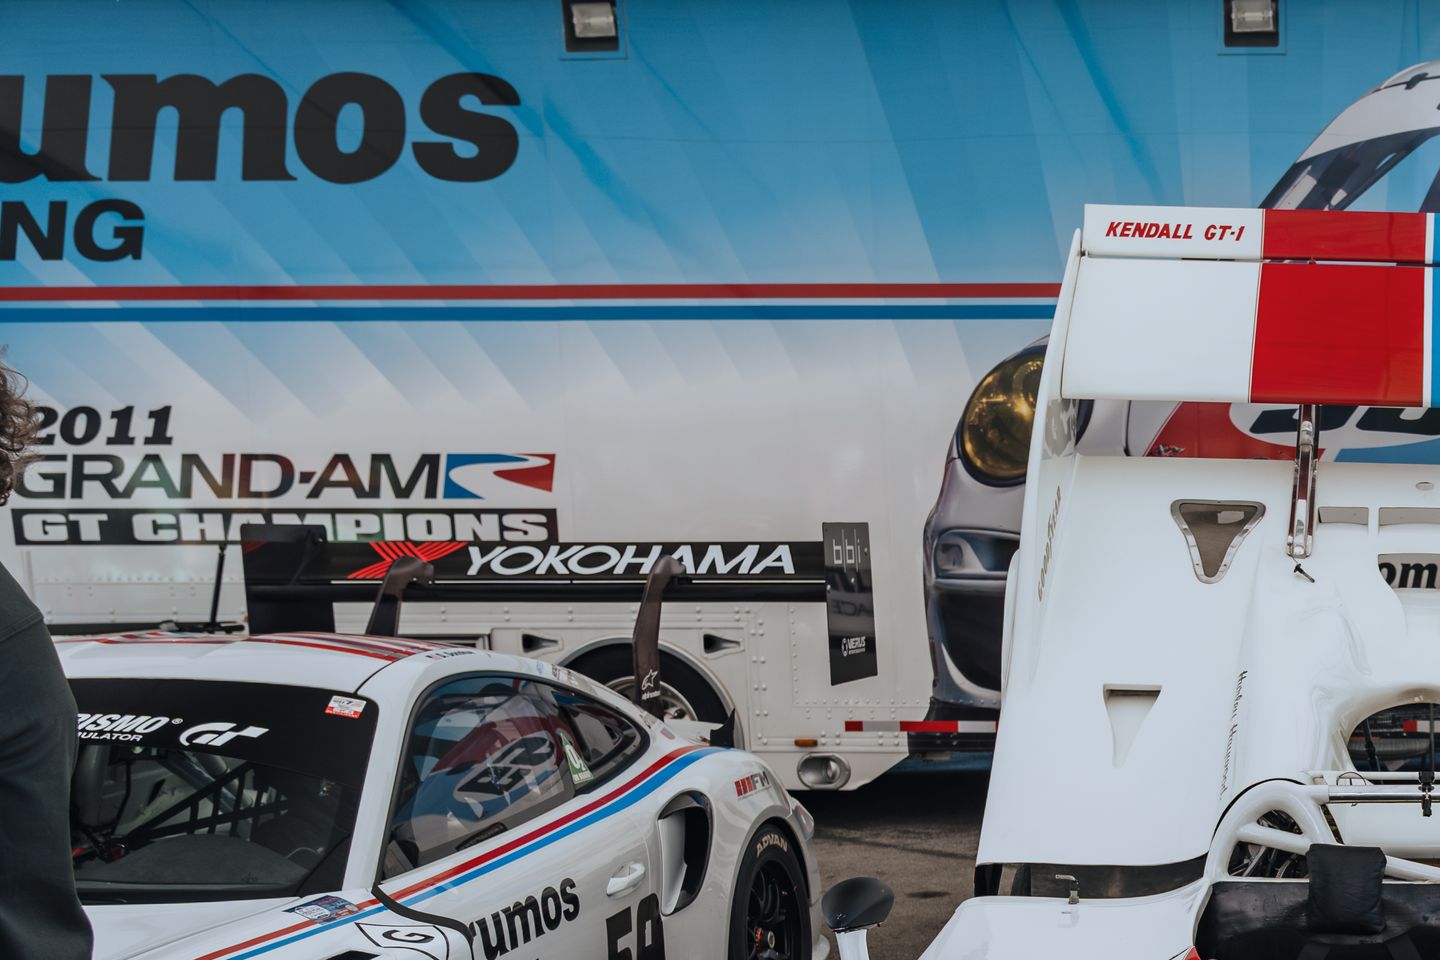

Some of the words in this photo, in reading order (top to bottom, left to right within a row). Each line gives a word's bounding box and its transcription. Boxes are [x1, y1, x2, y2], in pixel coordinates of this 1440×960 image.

[1105, 221, 1193, 240] KENDALL
[1203, 224, 1244, 242] GT-1
[32, 405, 173, 446] 2011
[14, 453, 441, 499] GRAND-AM
[22, 513, 108, 542] GT
[467, 544, 795, 576] YOKOHAMA
[756, 833, 788, 858] ADVAN
